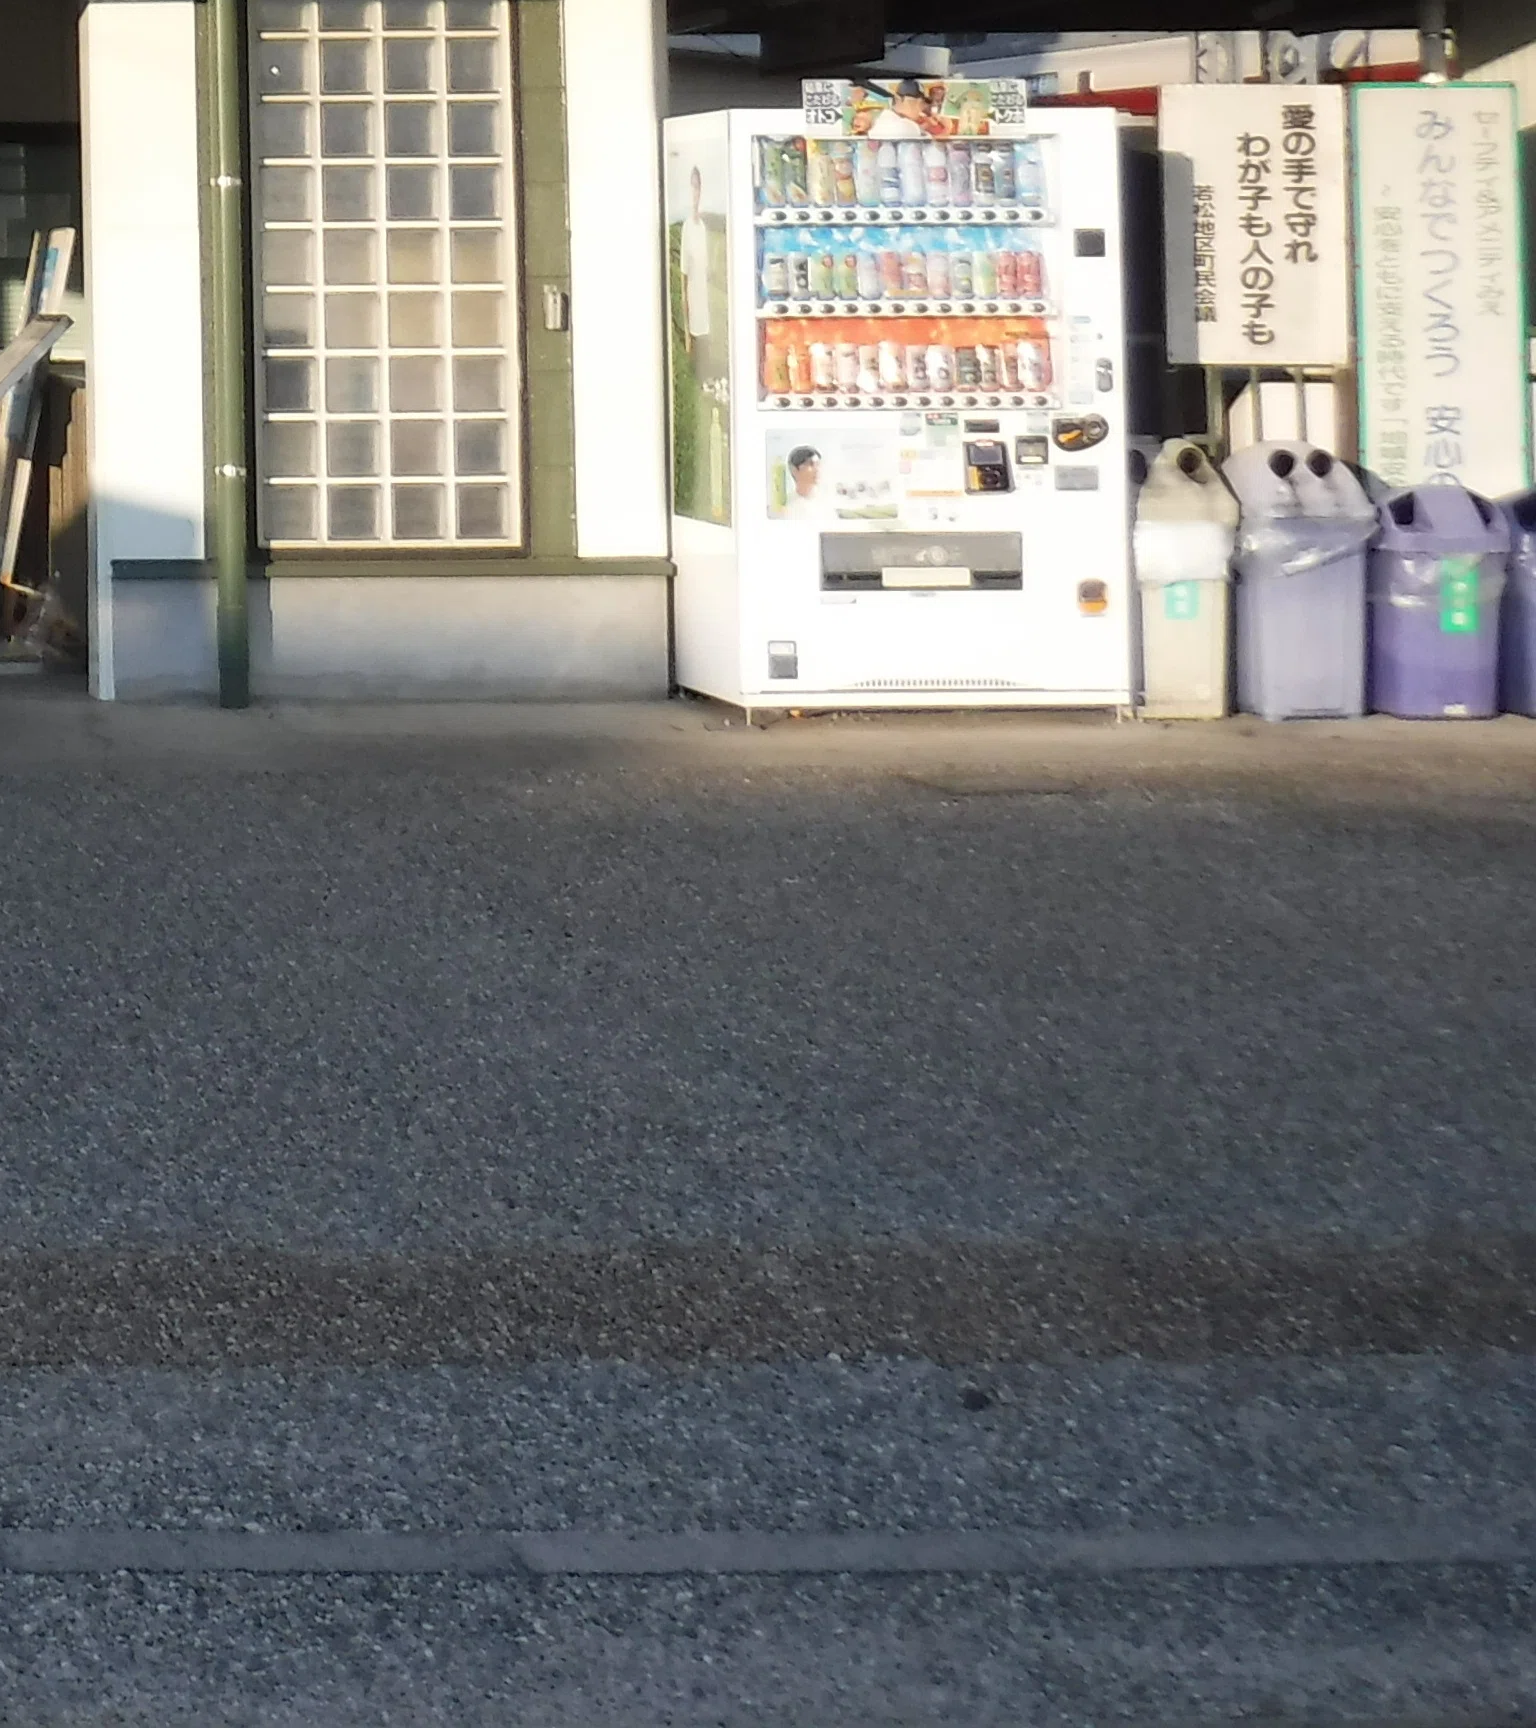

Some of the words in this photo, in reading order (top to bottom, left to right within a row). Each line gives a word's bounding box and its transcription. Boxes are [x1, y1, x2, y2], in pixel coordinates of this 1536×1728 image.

[1236, 131, 1275, 346] わが子も人の子も
[1281, 104, 1319, 264] 愛の手で守れ
[1415, 110, 1461, 377] みんなでつくろう
